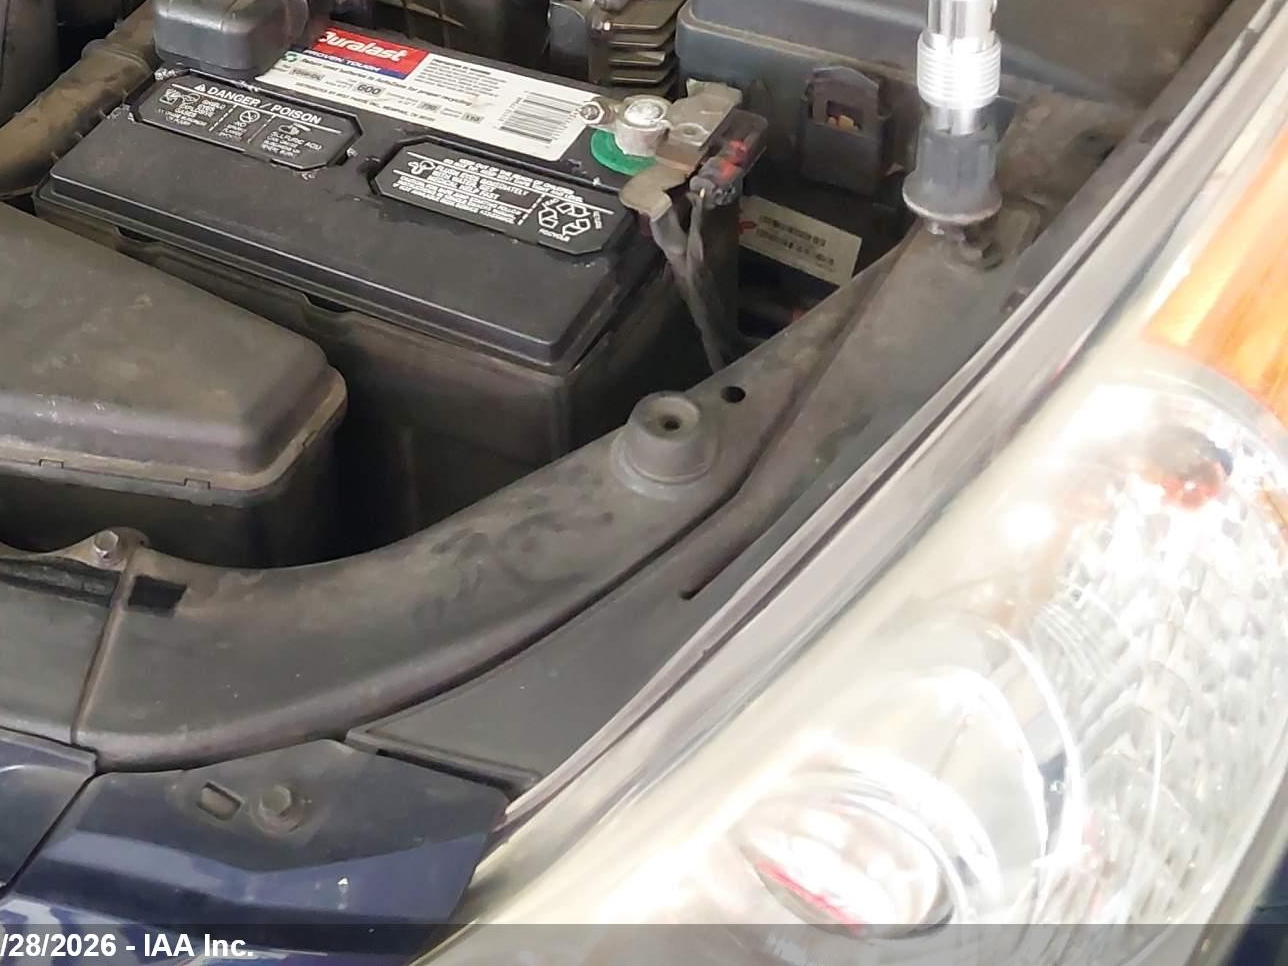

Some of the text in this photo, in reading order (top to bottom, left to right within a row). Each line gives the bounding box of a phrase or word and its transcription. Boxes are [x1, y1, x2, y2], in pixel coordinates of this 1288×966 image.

[356, 83, 382, 95] 600
[207, 86, 262, 108] DANGER
[271, 104, 322, 124] POISON
